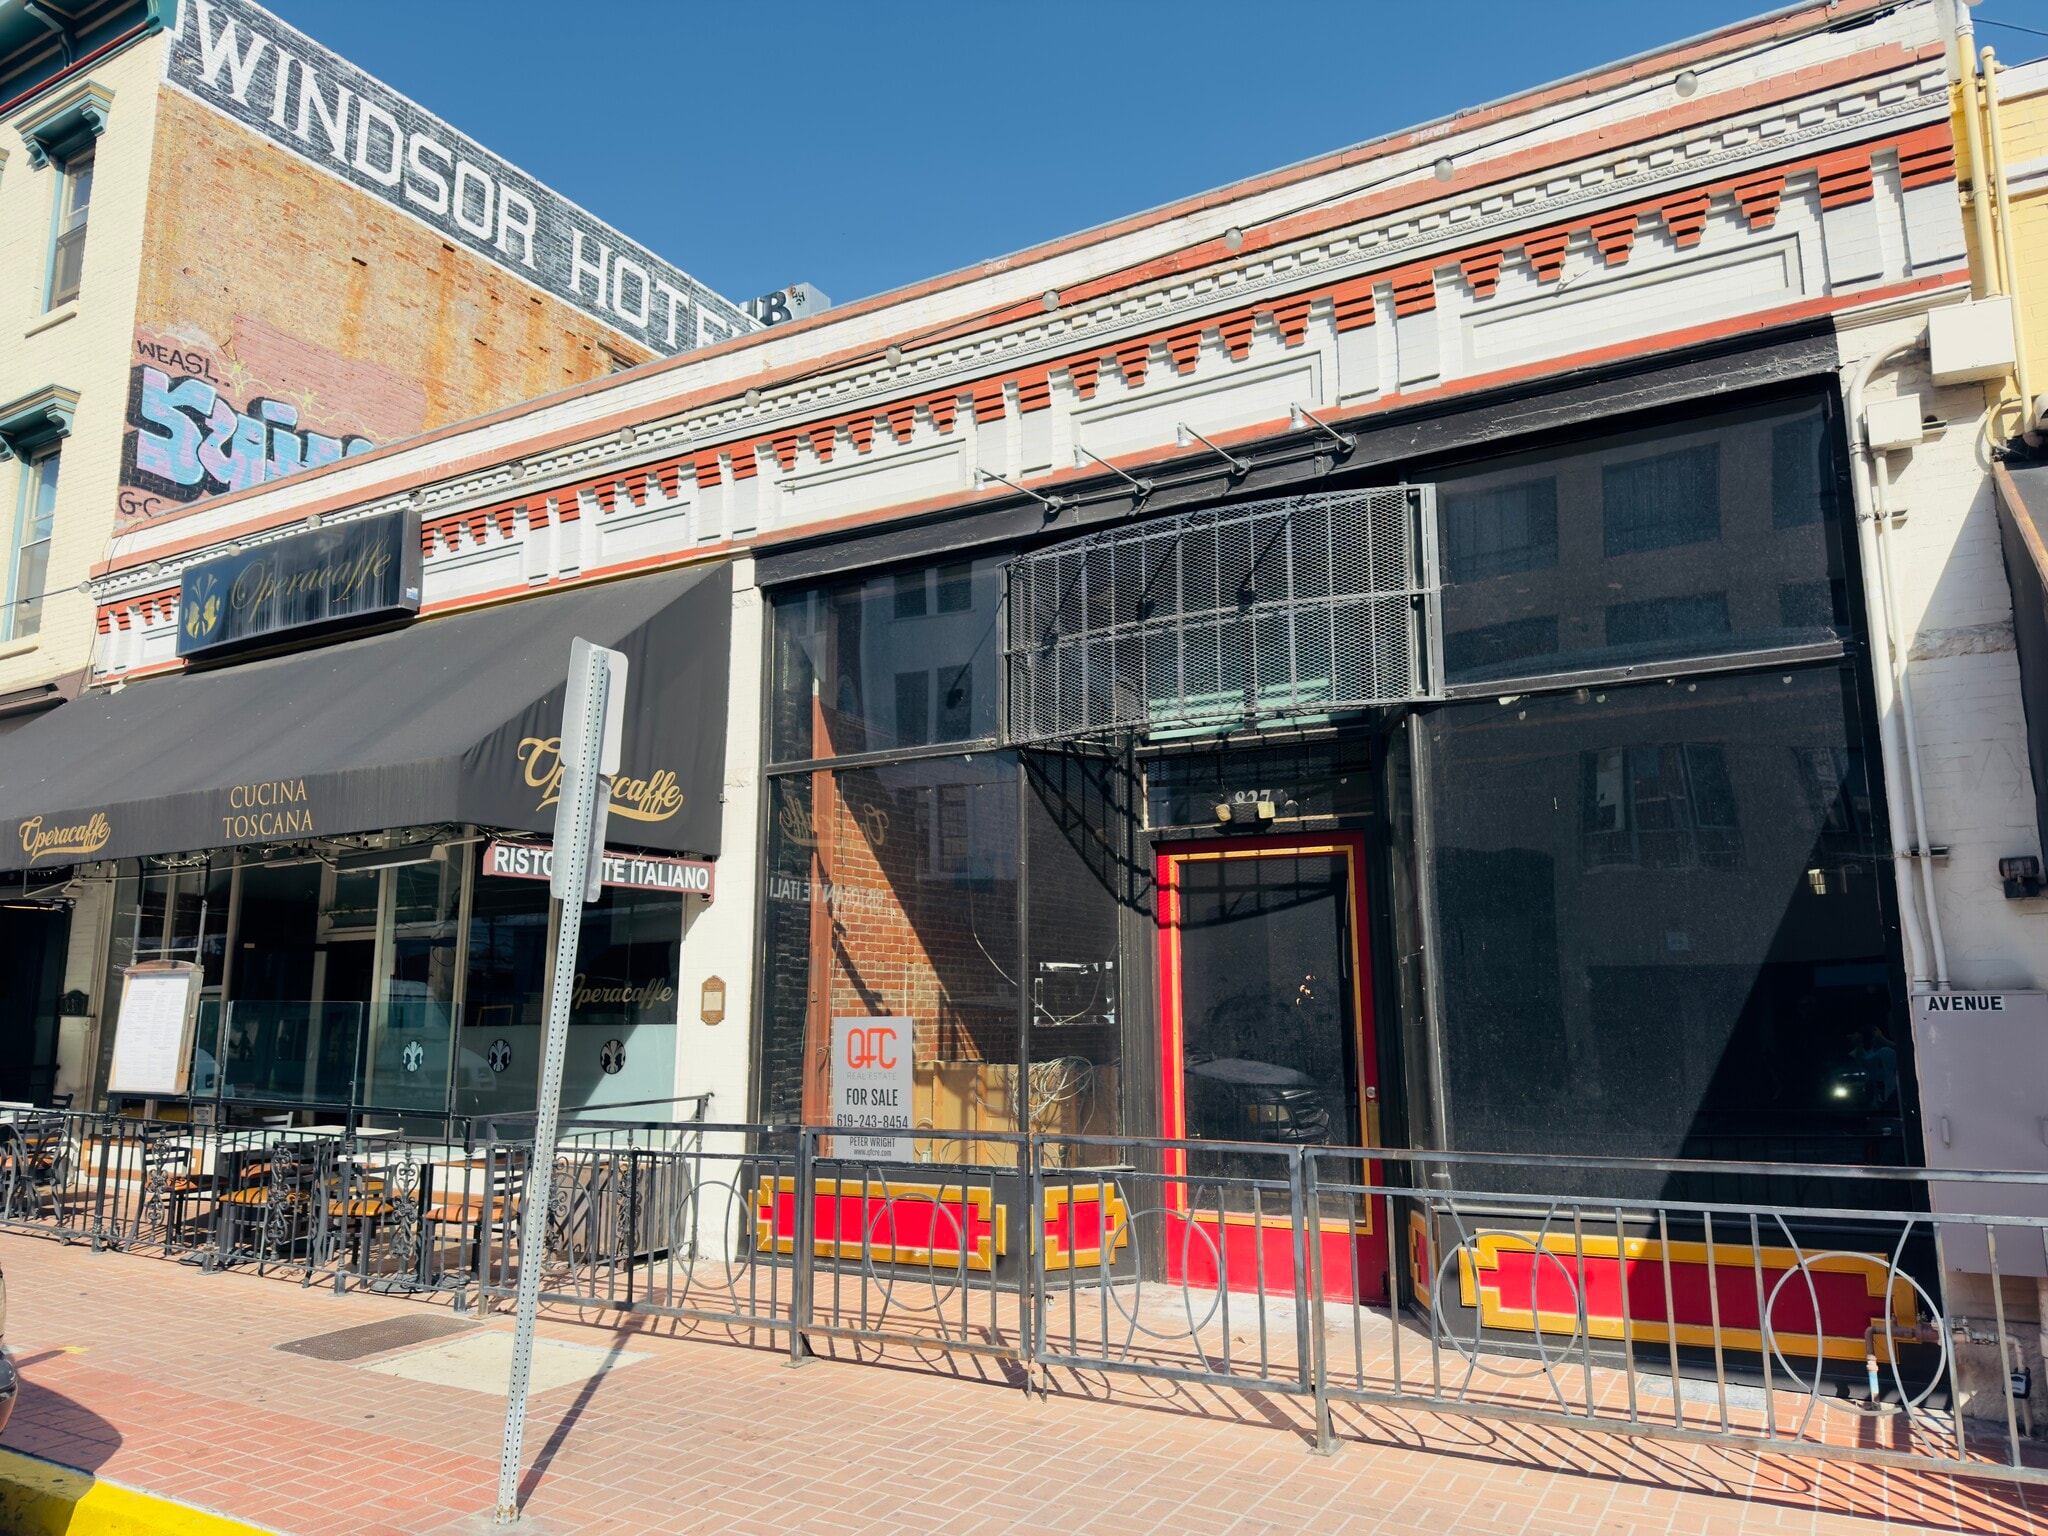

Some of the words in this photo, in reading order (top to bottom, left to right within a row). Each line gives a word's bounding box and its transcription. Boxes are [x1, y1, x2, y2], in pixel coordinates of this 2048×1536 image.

[196, 0, 538, 271] WINDSOR
[567, 225, 743, 350] HOTE
[231, 535, 392, 622] Operacaffe
[230, 778, 307, 809] CUCINA
[517, 737, 683, 821] Opcaffe
[19, 812, 111, 865] Operacaffe
[223, 808, 313, 839] TOSCANA
[495, 846, 626, 883] RISTOTE
[630, 860, 709, 890] ITALIANO
[1928, 996, 2003, 1011] AVENUE
[847, 1028, 897, 1069] QFC
[847, 1071, 866, 1080] REAL
[869, 1072, 897, 1080] ESTATE
[846, 1088, 867, 1105] FOR
[872, 1089, 898, 1106] SALE
[837, 1114, 908, 1128] 619-243-8454
[850, 1137, 868, 1147] PETER
[870, 1137, 895, 1147] WRIGHT
